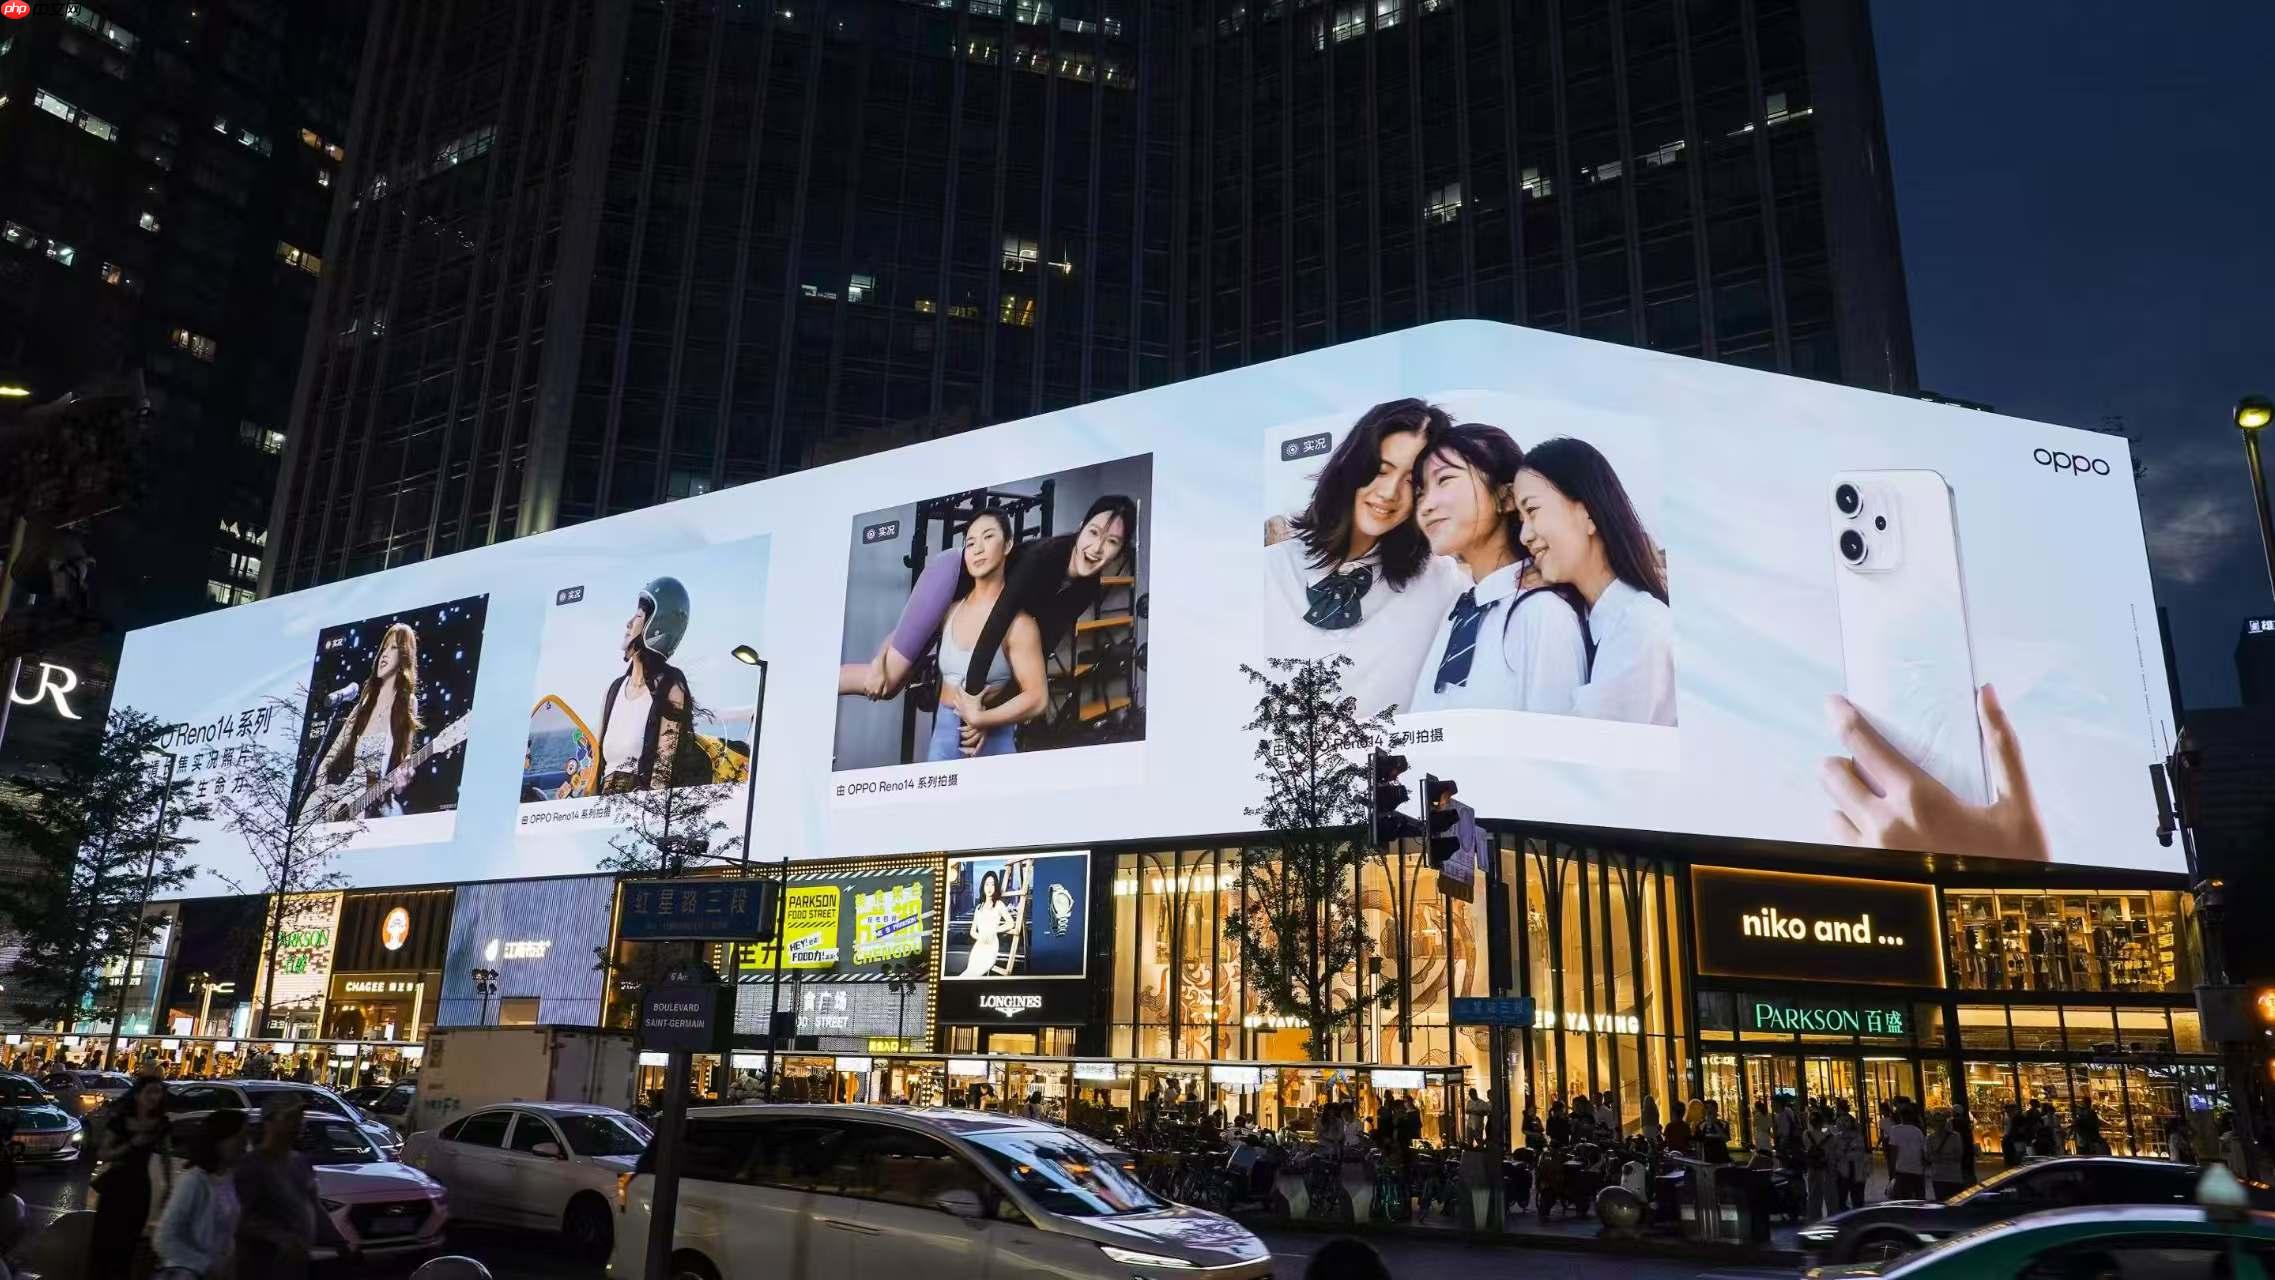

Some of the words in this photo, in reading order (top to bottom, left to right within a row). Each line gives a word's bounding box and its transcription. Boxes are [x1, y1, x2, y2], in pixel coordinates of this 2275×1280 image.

[10, 657, 82, 719] UR
[175, 714, 234, 747] Reno14
[236, 706, 273, 737] 系列
[836, 785, 845, 796] 由
[847, 782, 877, 795] OPPO
[879, 779, 914, 792] Reno14
[530, 813, 552, 823] OPPO
[633, 887, 748, 915] 红星路三段
[788, 894, 837, 908] PARKSON
[788, 910, 807, 919] FOOD
[809, 908, 836, 919] STREET
[1742, 907, 1807, 941] niko
[1814, 913, 1871, 944] and
[345, 982, 385, 992] CHAGEE
[653, 1003, 700, 1013] BOULEVARD
[980, 995, 1042, 1008] LONGINES
[645, 1018, 705, 1029] SAINT-GERMAIN
[1755, 1003, 1861, 1032] PARKSON
[1865, 1010, 1904, 1033] 百盛
